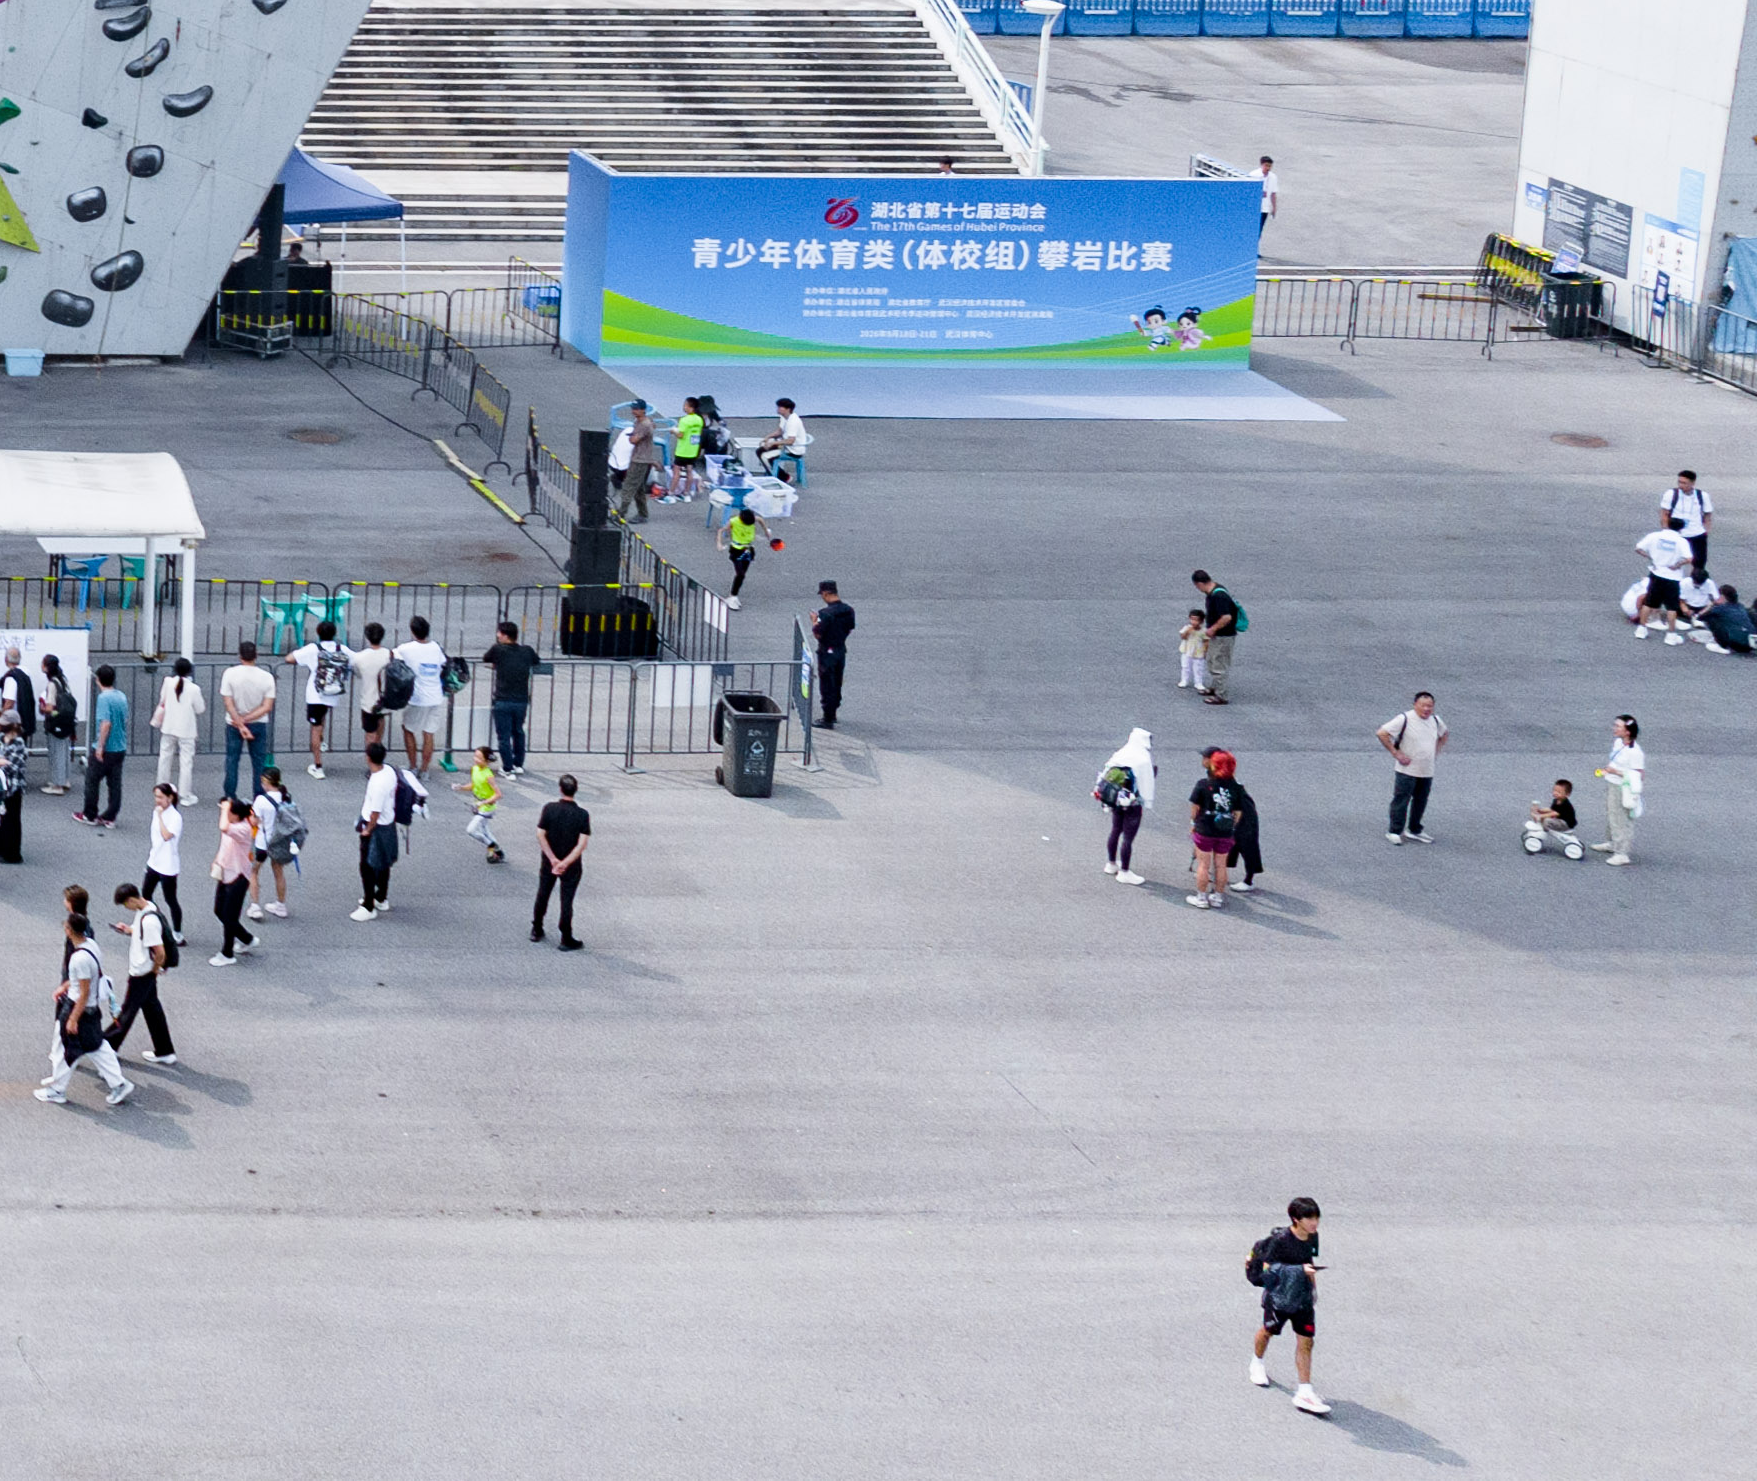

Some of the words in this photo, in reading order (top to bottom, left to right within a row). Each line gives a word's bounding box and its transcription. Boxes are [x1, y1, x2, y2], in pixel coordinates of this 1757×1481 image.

[870, 201, 1047, 220] 湖北省第十七届运动会
[871, 221, 889, 232] The
[892, 221, 915, 232] 17th
[917, 221, 952, 232] Games
[954, 221, 965, 232] of
[966, 221, 998, 232] Hubei
[999, 221, 1046, 232] Province
